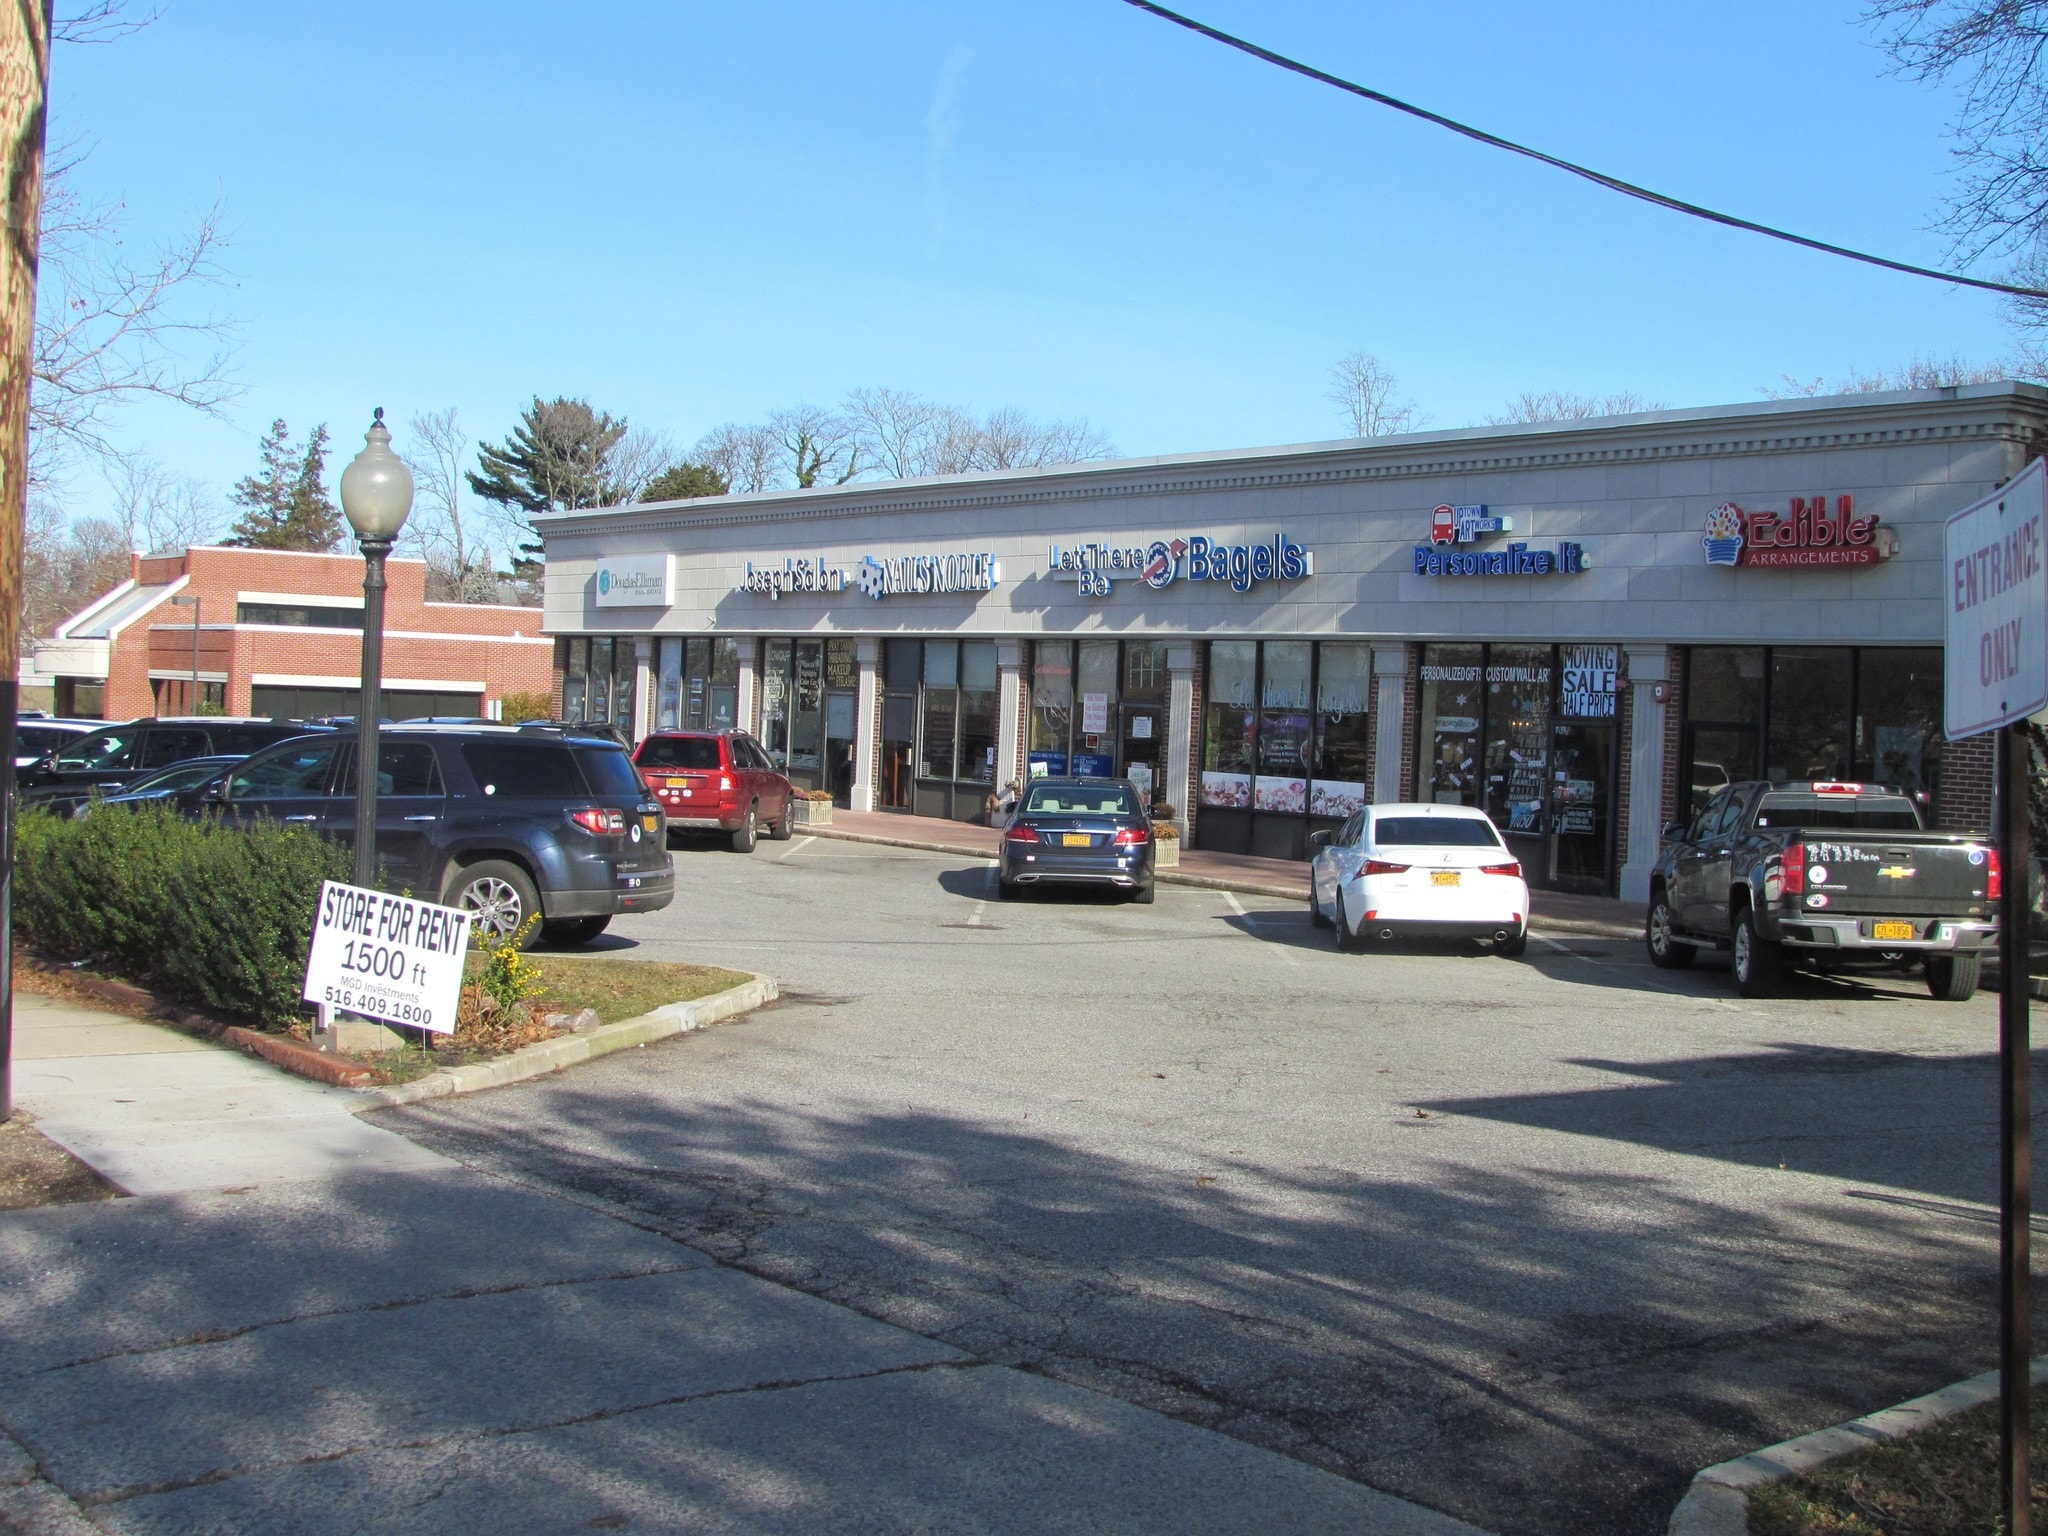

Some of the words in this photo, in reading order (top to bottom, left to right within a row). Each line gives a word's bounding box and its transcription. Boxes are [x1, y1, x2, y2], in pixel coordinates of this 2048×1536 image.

[1748, 496, 1869, 548] Edible
[883, 556, 930, 594] NAILS
[933, 553, 991, 593] NOBLE
[1048, 544, 1083, 570] Let
[1086, 543, 1146, 570] There
[1188, 534, 1305, 592] Bagels
[1414, 543, 1549, 577] Personalize
[1558, 542, 1578, 574] It
[1750, 551, 1869, 576] ARRANGEMENTS
[1954, 515, 2040, 613] ENTRANCE
[739, 557, 793, 601] Joseph
[795, 557, 842, 592] Salon
[1078, 570, 1110, 596] Be
[1563, 646, 1614, 669] MOVING
[1980, 616, 2022, 688] ONLY
[1420, 665, 1466, 681] PERSONALIZED
[1485, 666, 1516, 682] CUSTOM
[1516, 667, 1537, 682] WALL
[1564, 670, 1616, 693] SALE
[1562, 693, 1586, 716] HALF
[1587, 693, 1616, 717] PRICE
[323, 886, 377, 937] STORE
[377, 898, 414, 946] FOR
[415, 906, 466, 956] RENT
[341, 939, 405, 981] 1500
[412, 963, 427, 986] ft
[325, 985, 432, 1025] 516.409.1800
[340, 975, 363, 991] MGD
[364, 980, 420, 1004] Investments
